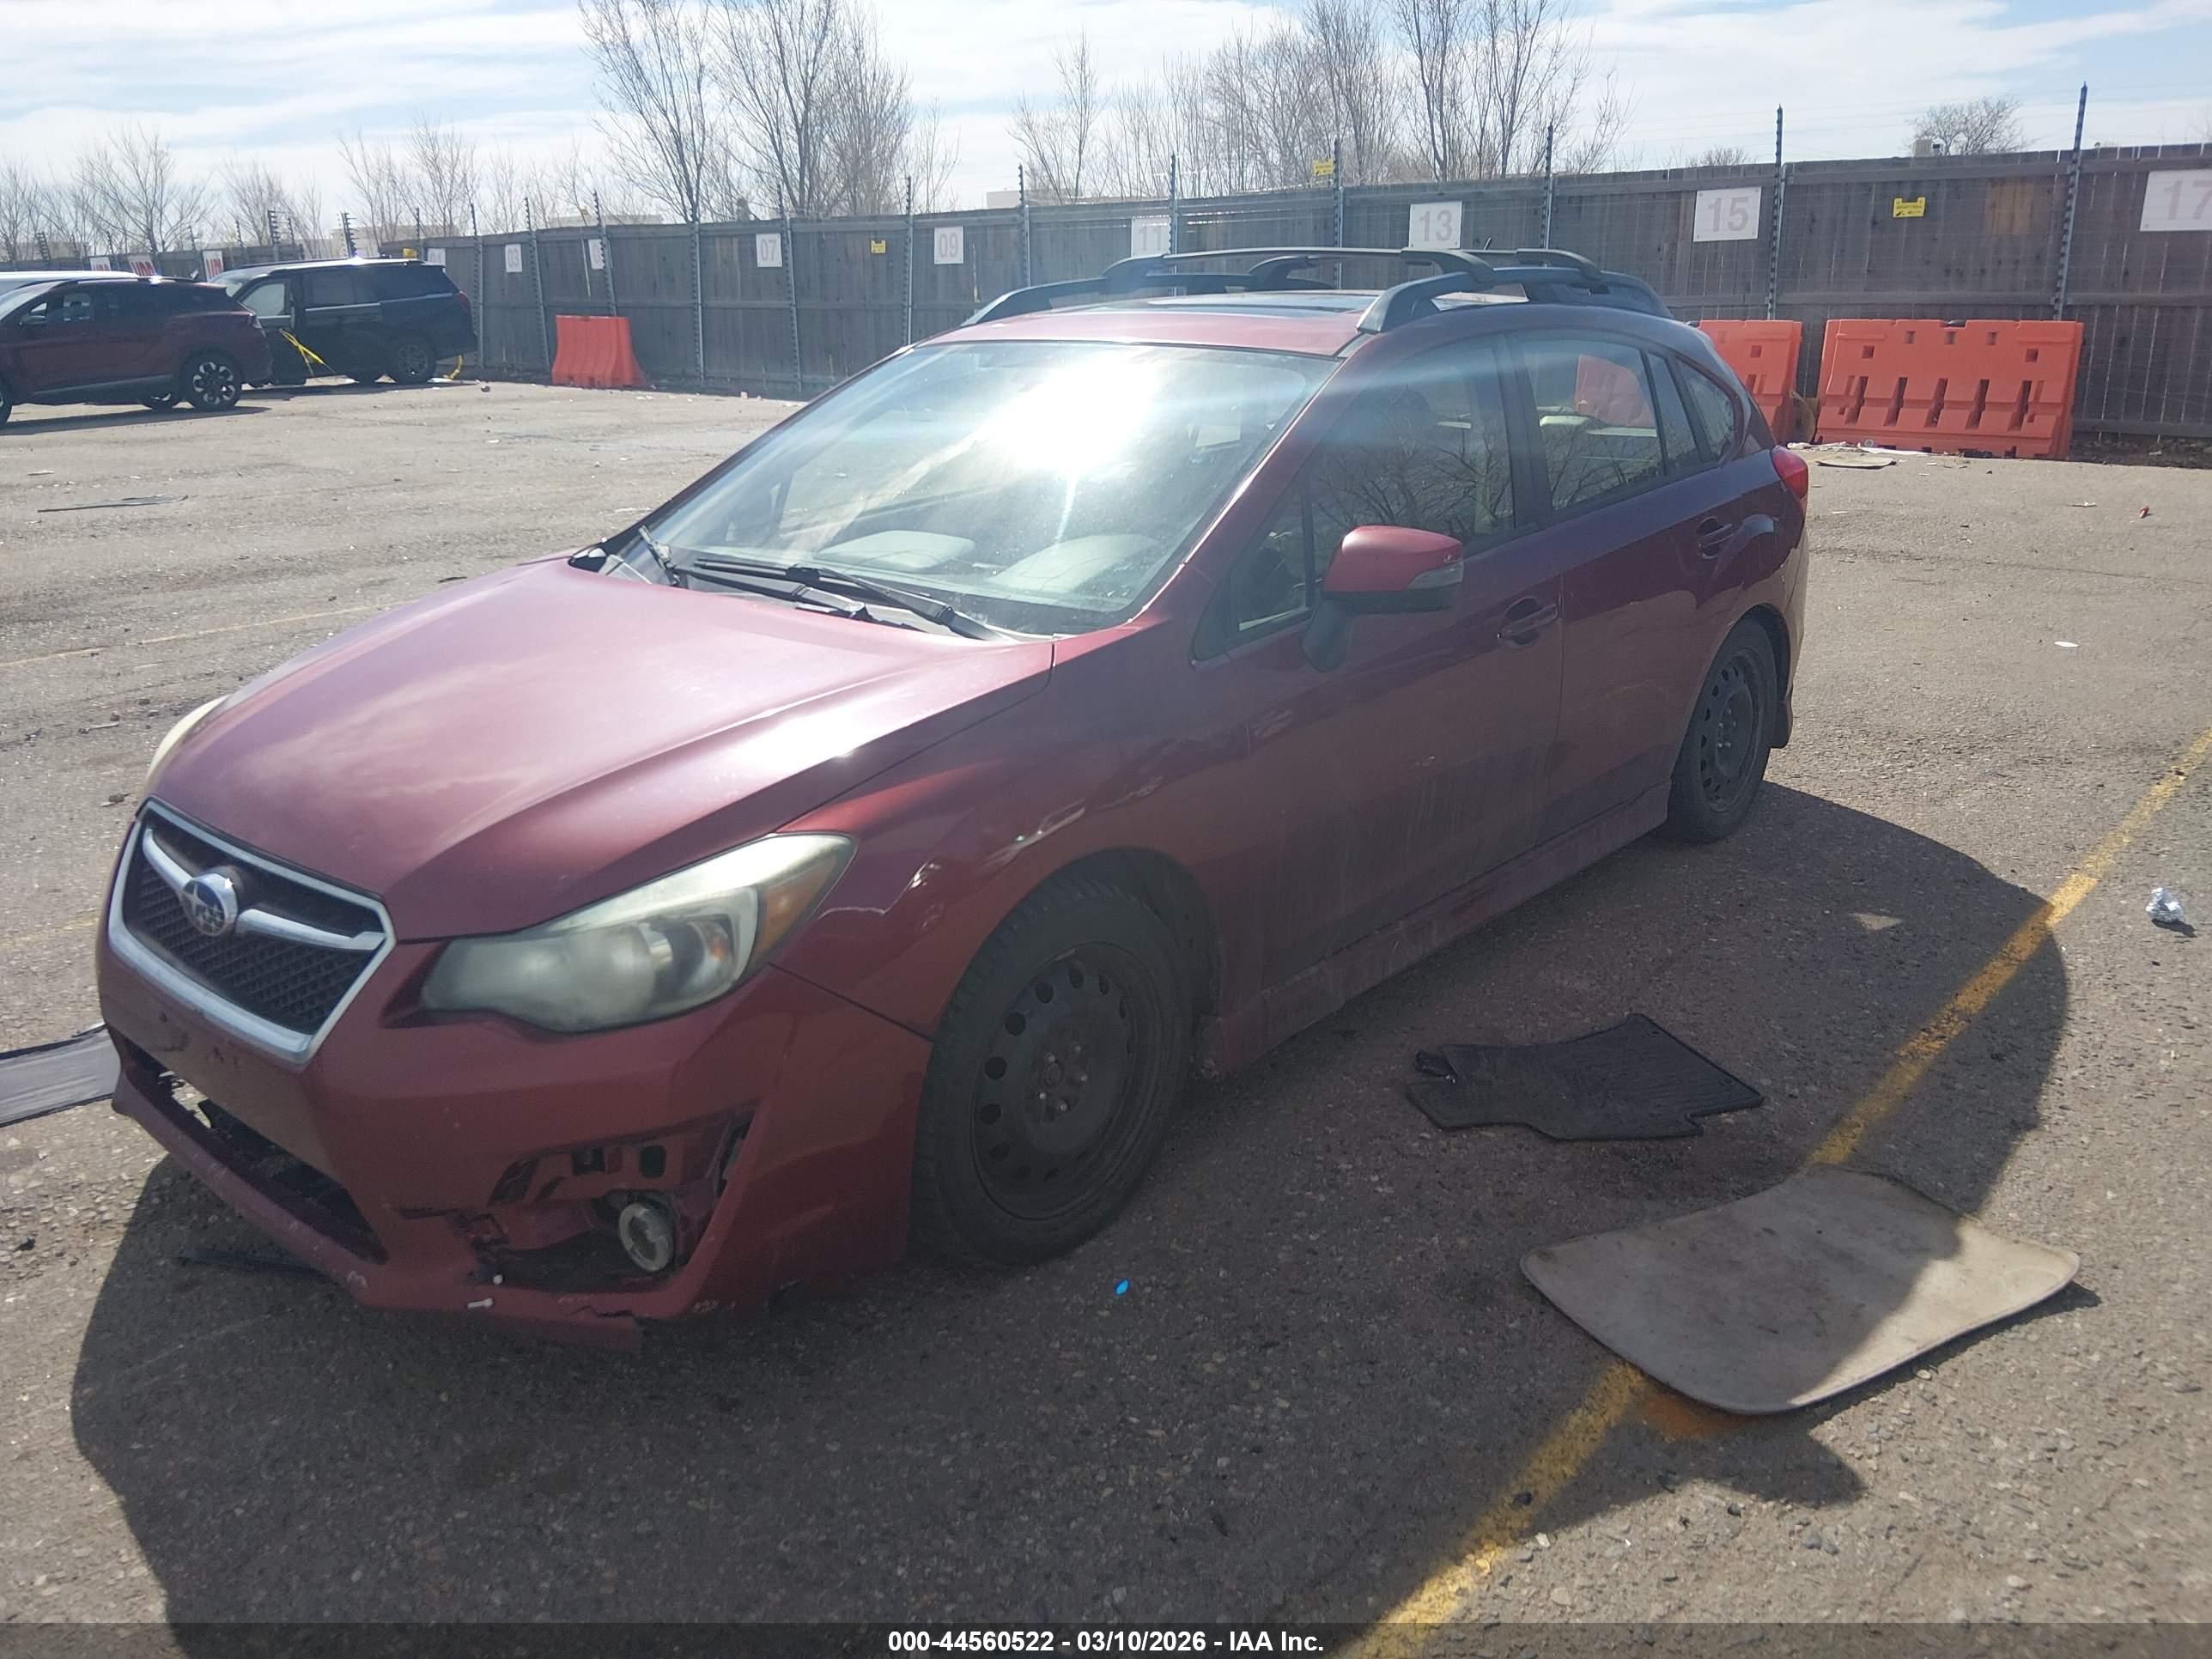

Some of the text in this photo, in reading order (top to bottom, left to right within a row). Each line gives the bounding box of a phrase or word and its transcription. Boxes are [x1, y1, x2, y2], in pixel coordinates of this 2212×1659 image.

[2162, 179, 2212, 220] 17
[1419, 210, 1453, 242] 13
[1707, 197, 1750, 233] 15
[760, 239, 777, 262] 07
[939, 233, 958, 258] 09
[1139, 227, 1162, 251] 11
